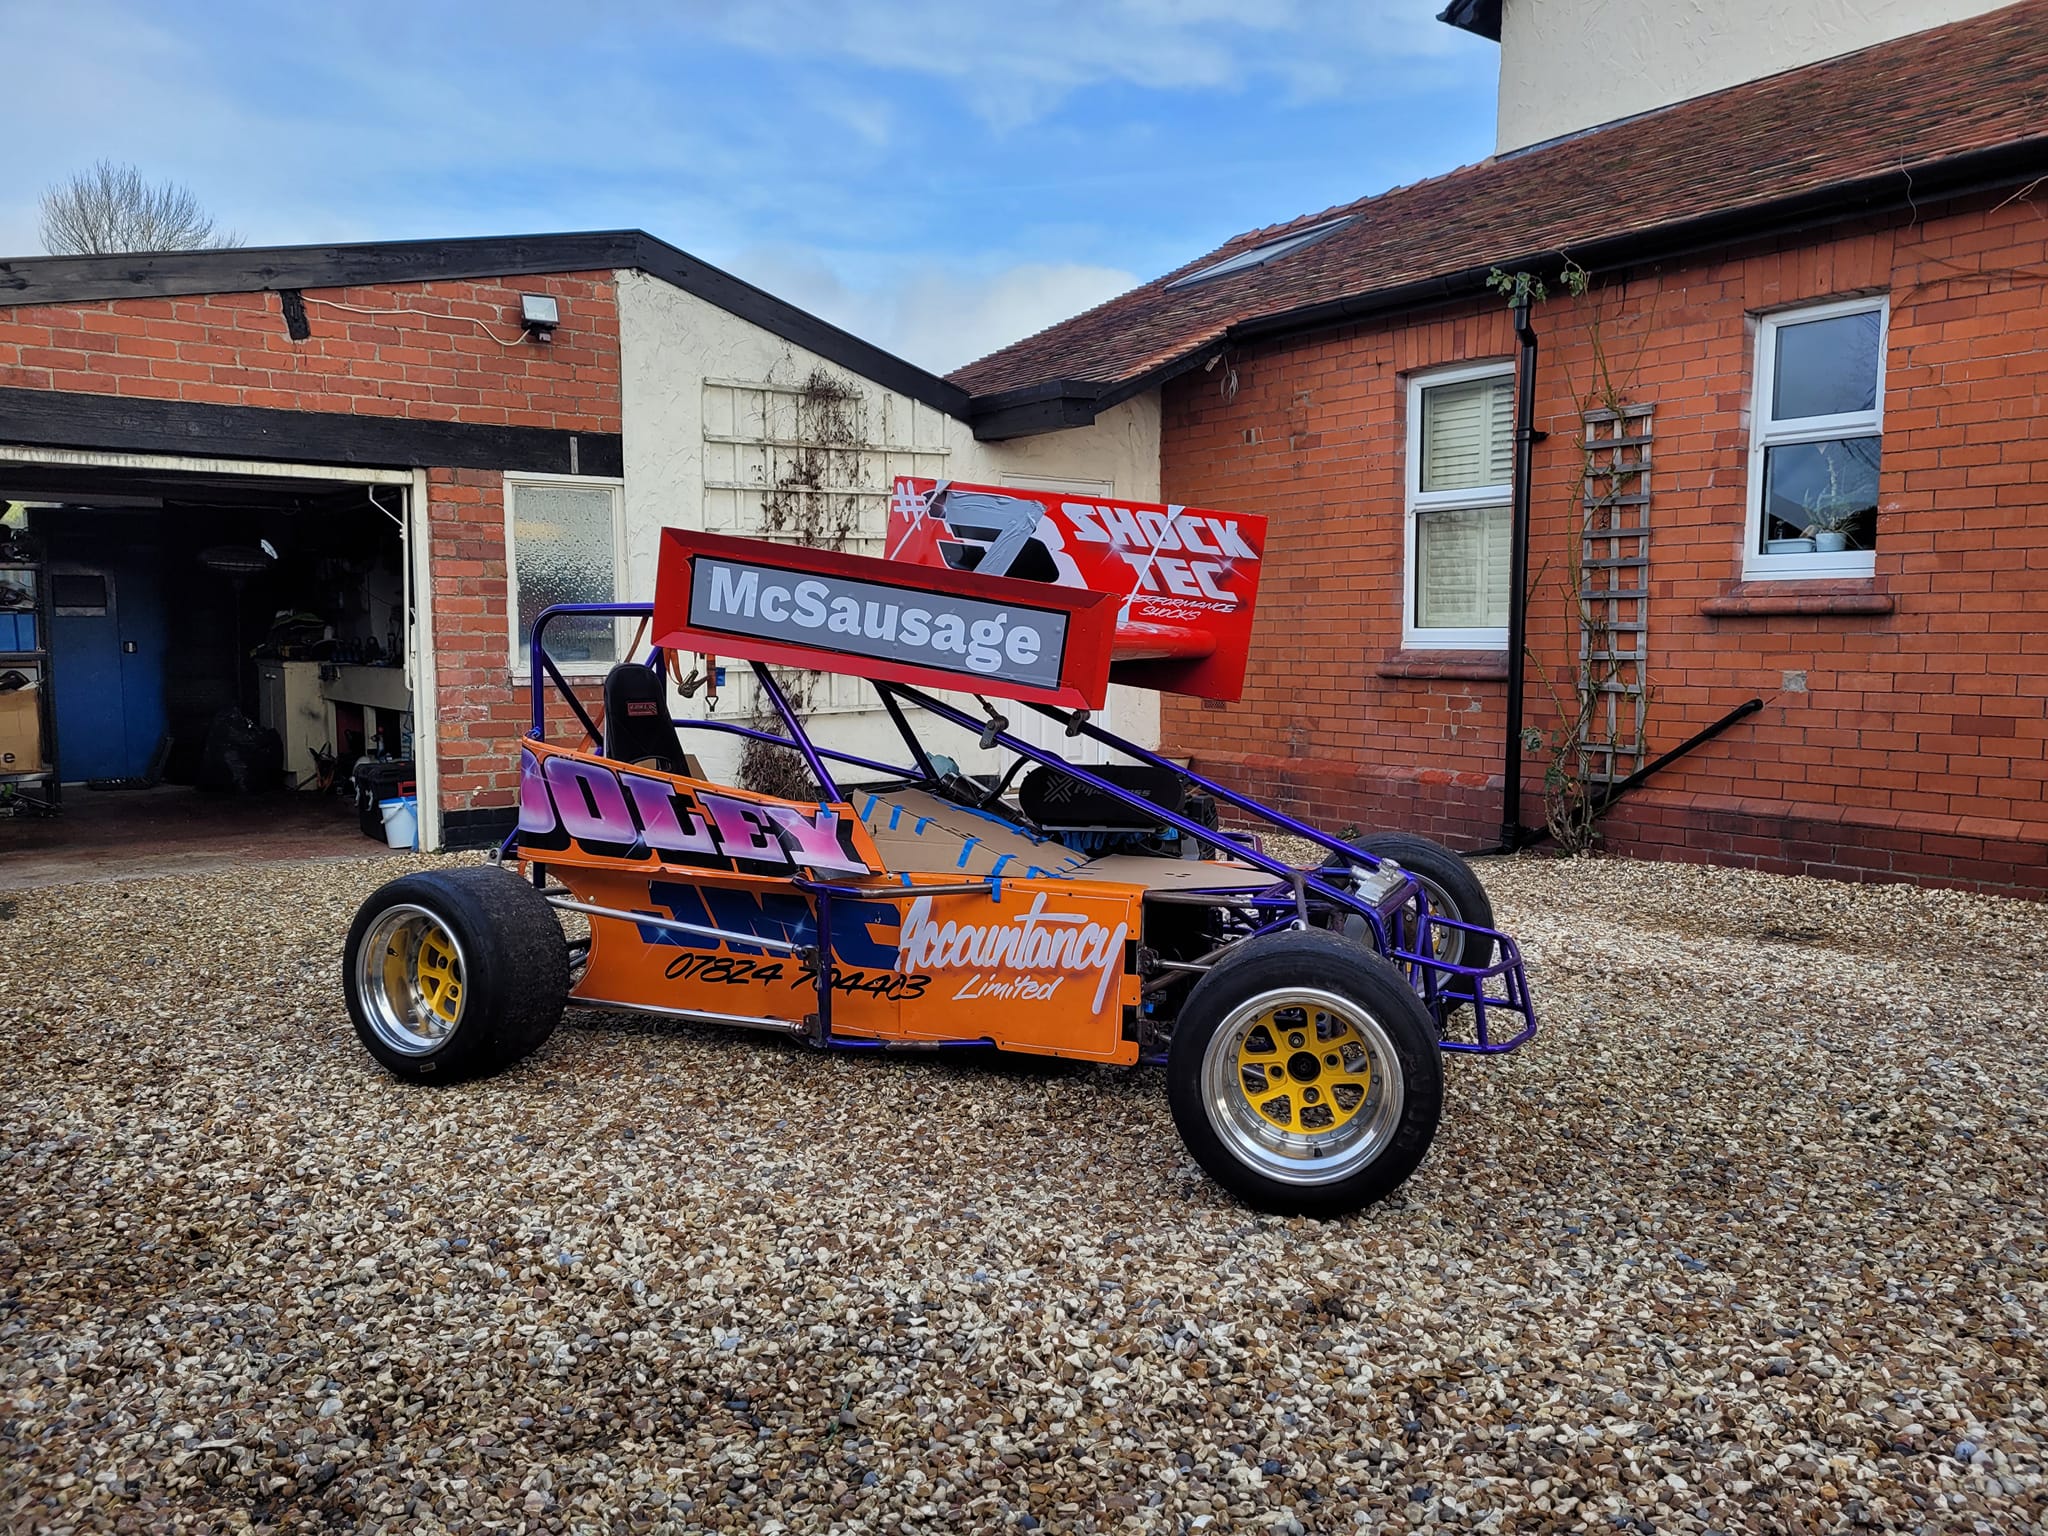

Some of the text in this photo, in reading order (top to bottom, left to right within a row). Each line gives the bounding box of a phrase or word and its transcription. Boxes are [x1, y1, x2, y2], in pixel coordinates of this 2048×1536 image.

[1060, 502, 1260, 560] SHOCK
[1120, 552, 1239, 602] TEC
[708, 565, 1042, 673] McSausage
[664, 952, 784, 987] 07824
[894, 891, 1128, 1015] Accountancy
[952, 973, 1065, 1001] Limited
